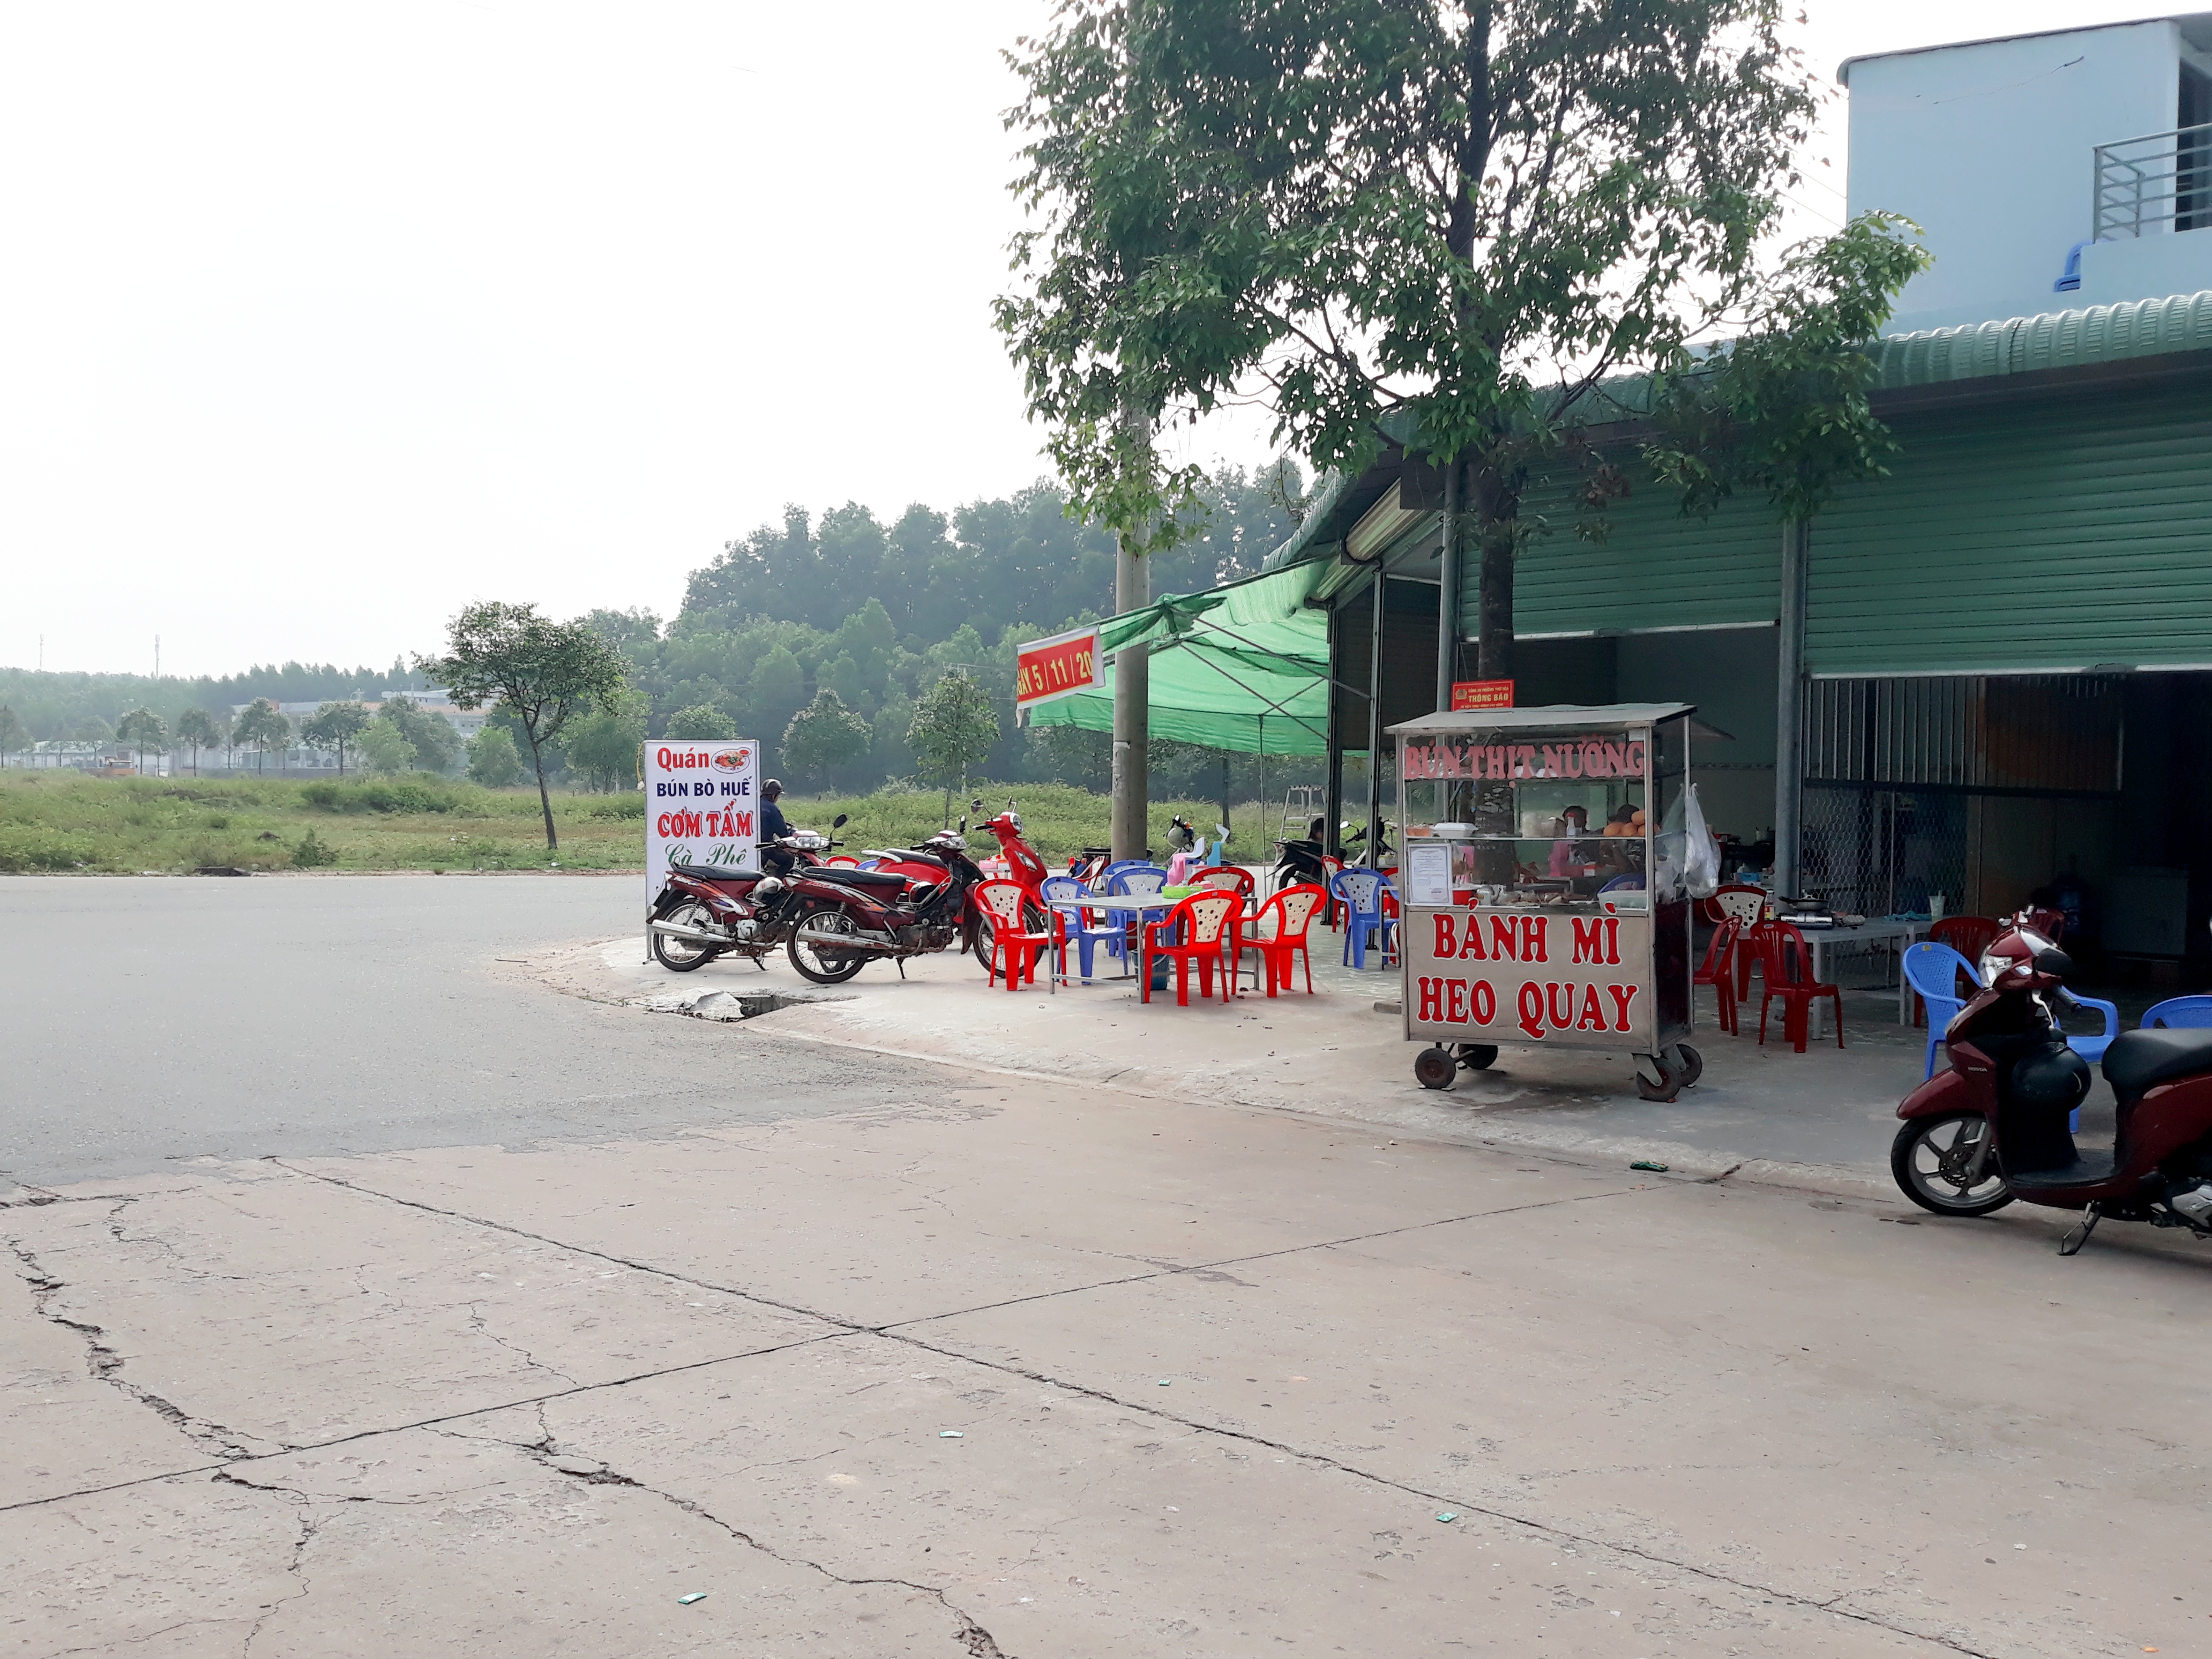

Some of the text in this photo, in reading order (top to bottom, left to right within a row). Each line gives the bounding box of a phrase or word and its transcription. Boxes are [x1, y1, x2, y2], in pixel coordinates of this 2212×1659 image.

[1468, 692, 1508, 703] THÔNG BÁO
[657, 748, 709, 772] Quán
[1404, 739, 1462, 779] BÚN
[1467, 745, 1536, 788] THỊT
[657, 776, 752, 797] BÚN BÒ HUẾ
[657, 799, 753, 838] CƠM TẤM
[665, 843, 747, 865] Cà Phê
[1432, 898, 1621, 966] BÁNH MÌ
[1417, 976, 1639, 1040] HEO QUAY
